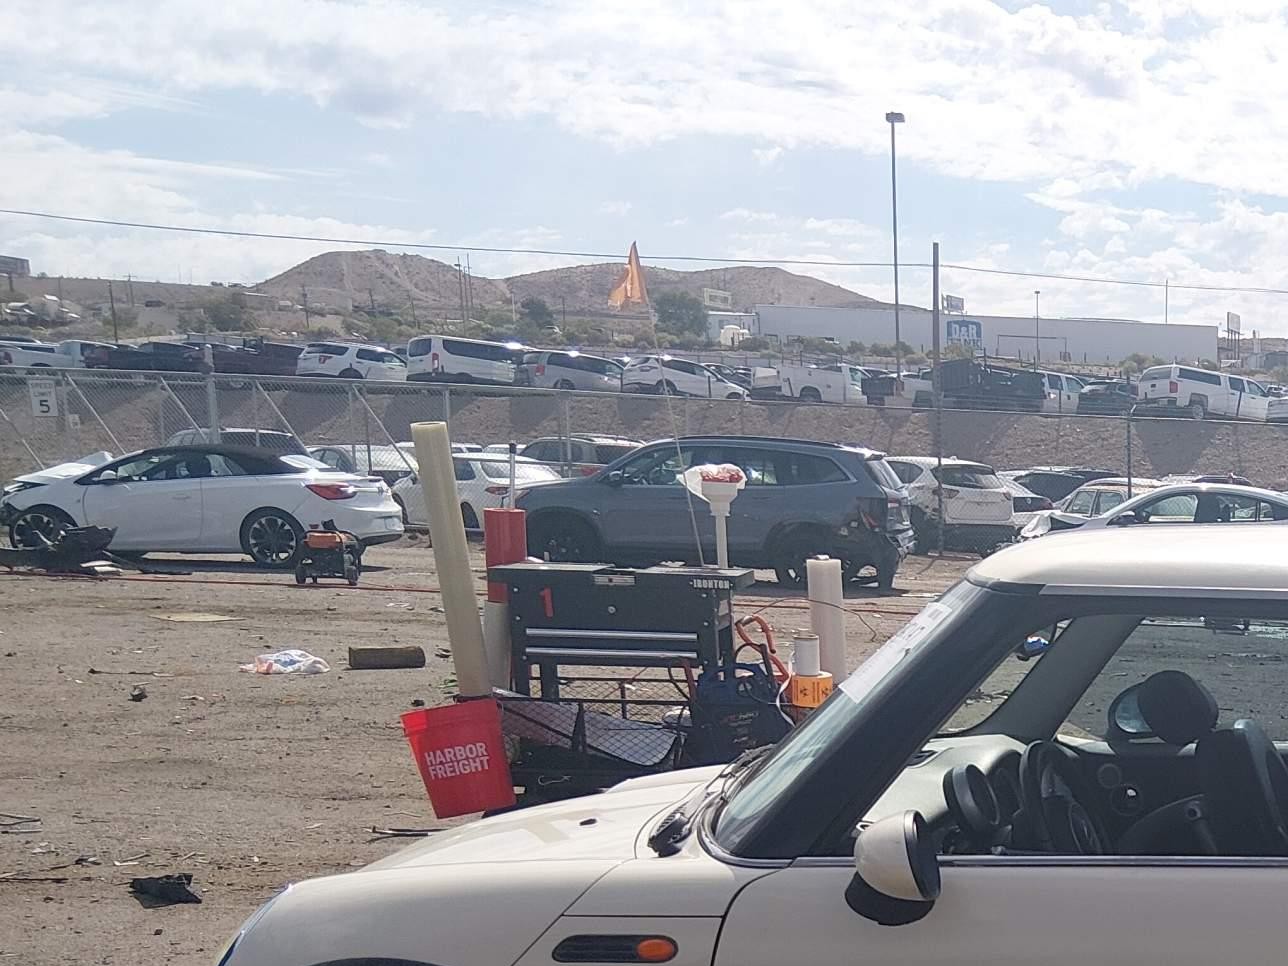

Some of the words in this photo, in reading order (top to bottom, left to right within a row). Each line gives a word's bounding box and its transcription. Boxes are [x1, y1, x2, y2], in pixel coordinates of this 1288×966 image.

[951, 322, 978, 339] D&R
[40, 400, 50, 413] 5
[693, 579, 730, 589] IRONTON
[540, 588, 554, 617] 1
[424, 742, 489, 766] HARBOR
[428, 756, 490, 780] FREIGHT
